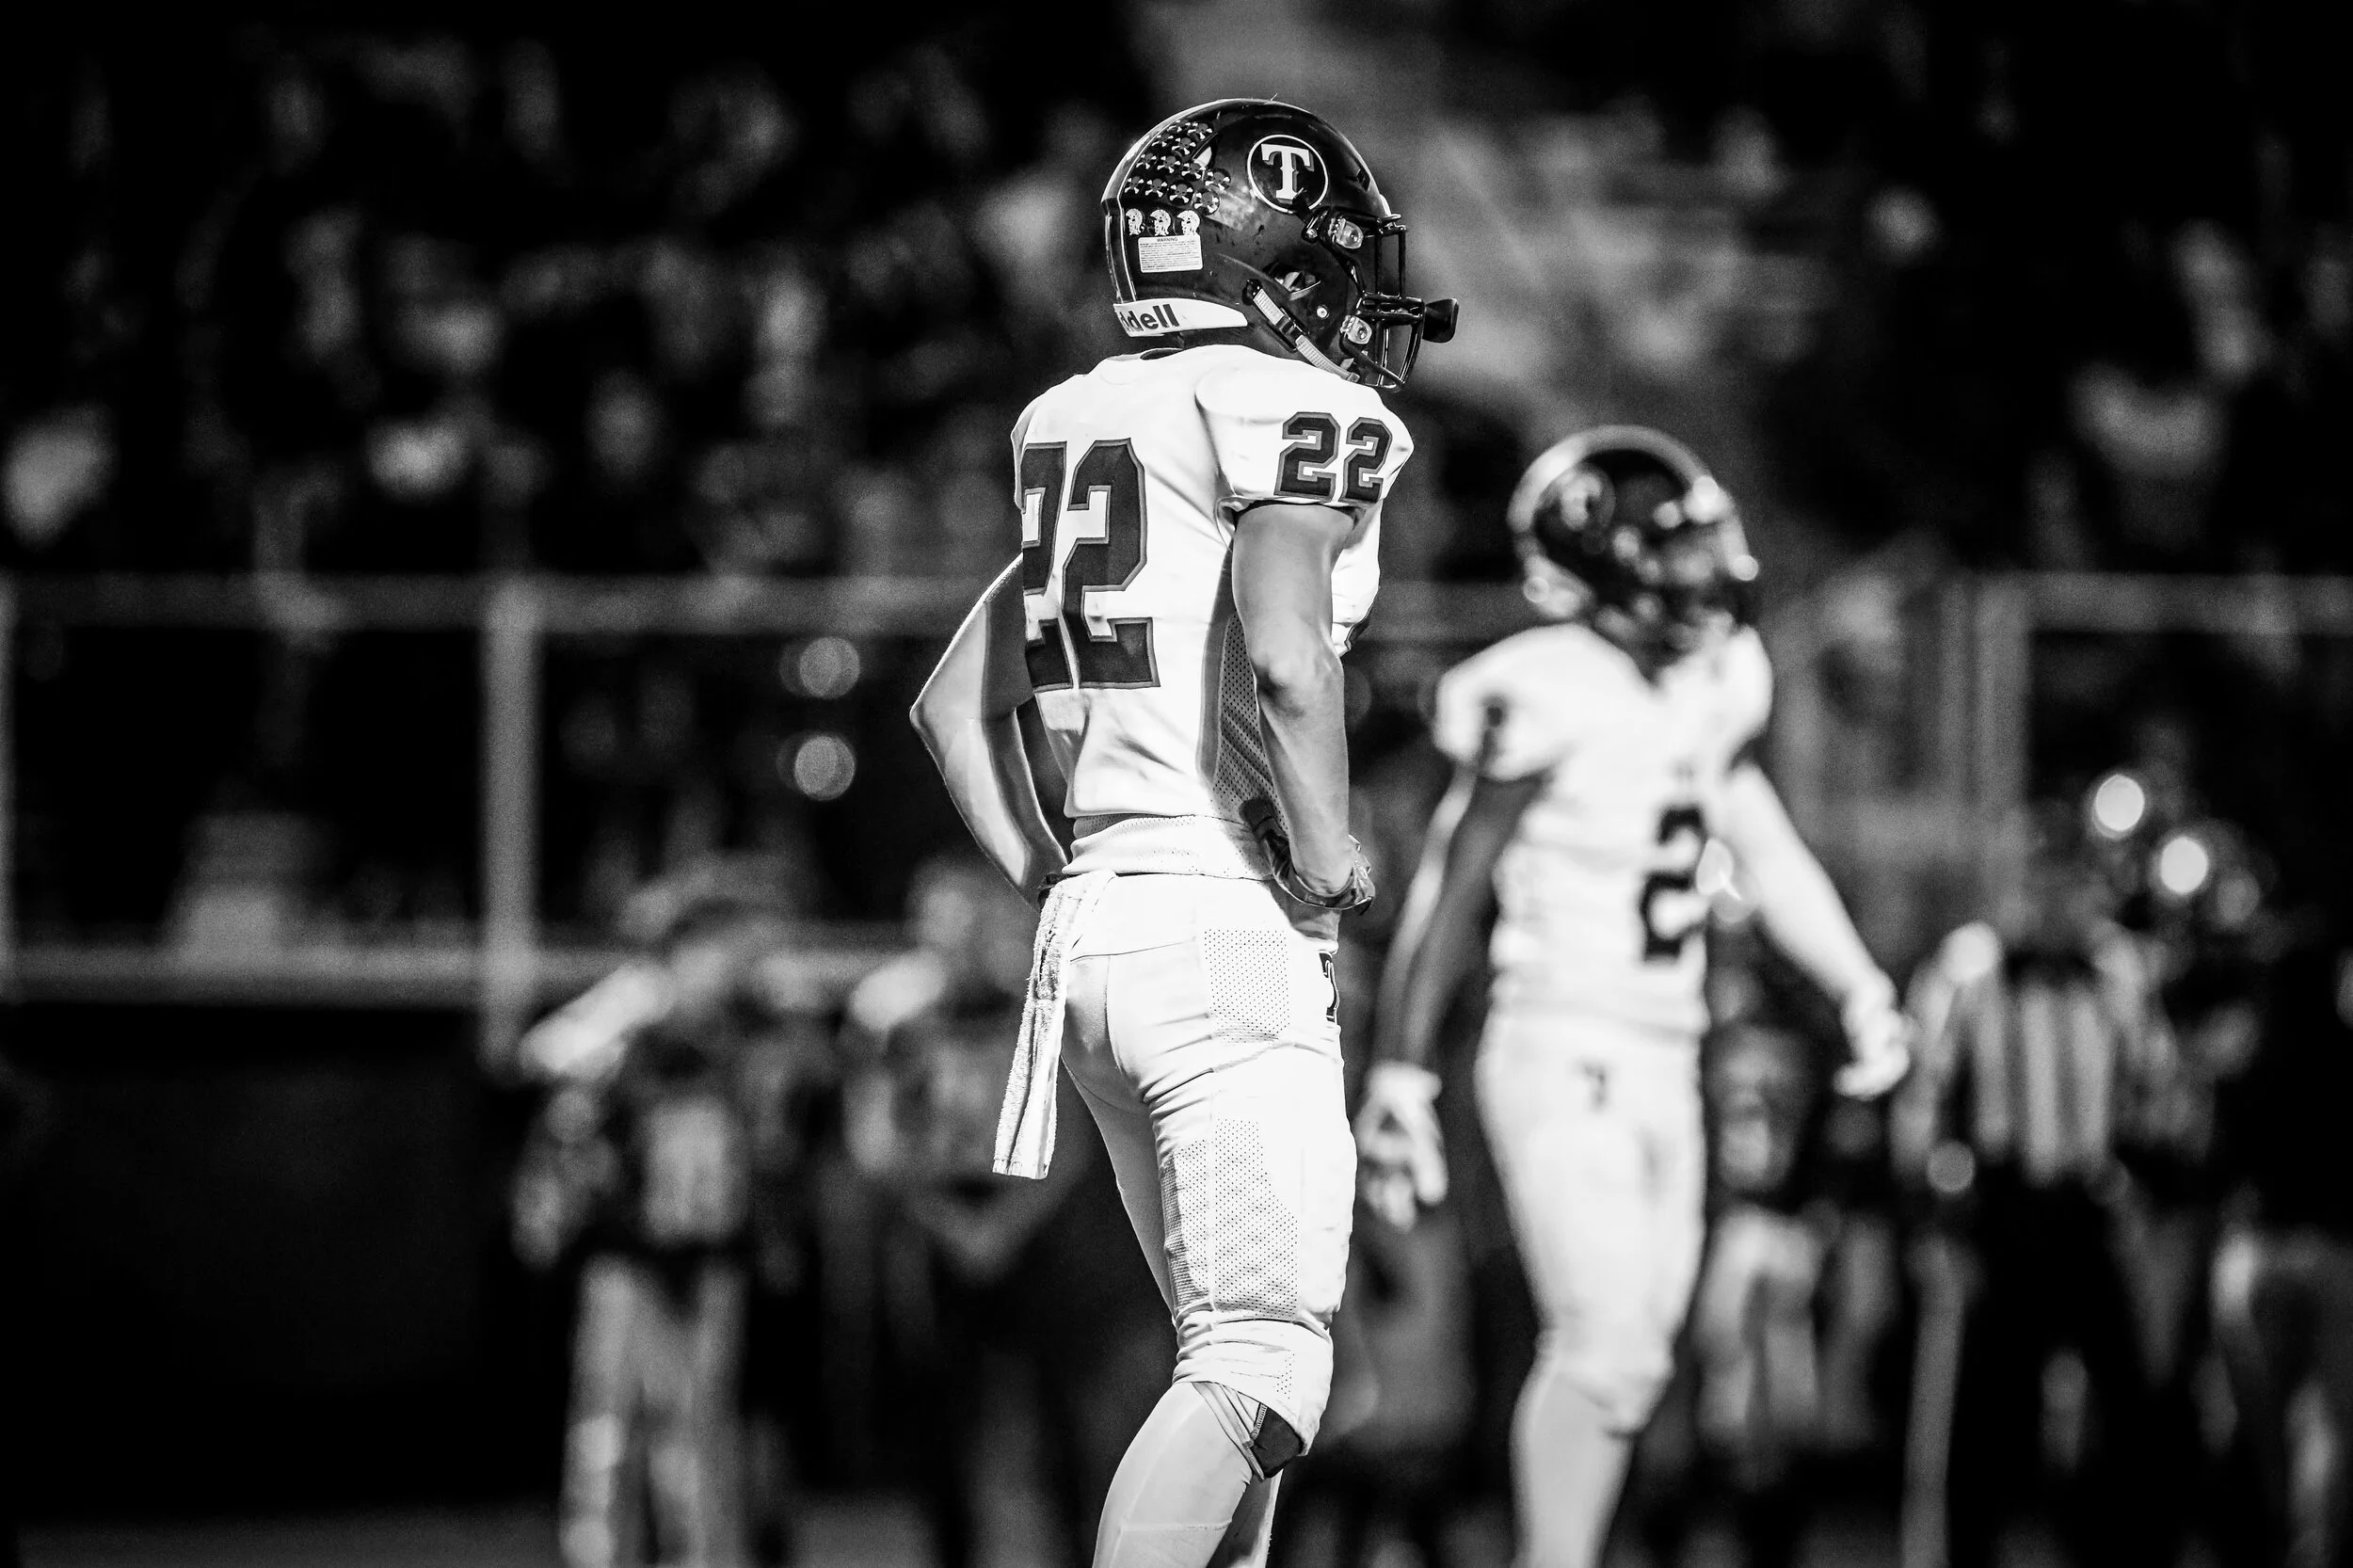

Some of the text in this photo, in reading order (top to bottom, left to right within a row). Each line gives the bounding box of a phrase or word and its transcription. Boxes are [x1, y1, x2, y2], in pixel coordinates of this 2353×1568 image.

[1261, 143, 1314, 204] T
[1273, 411, 1392, 504] 22
[1020, 438, 1160, 692] 22
[1640, 806, 1705, 960] 2
